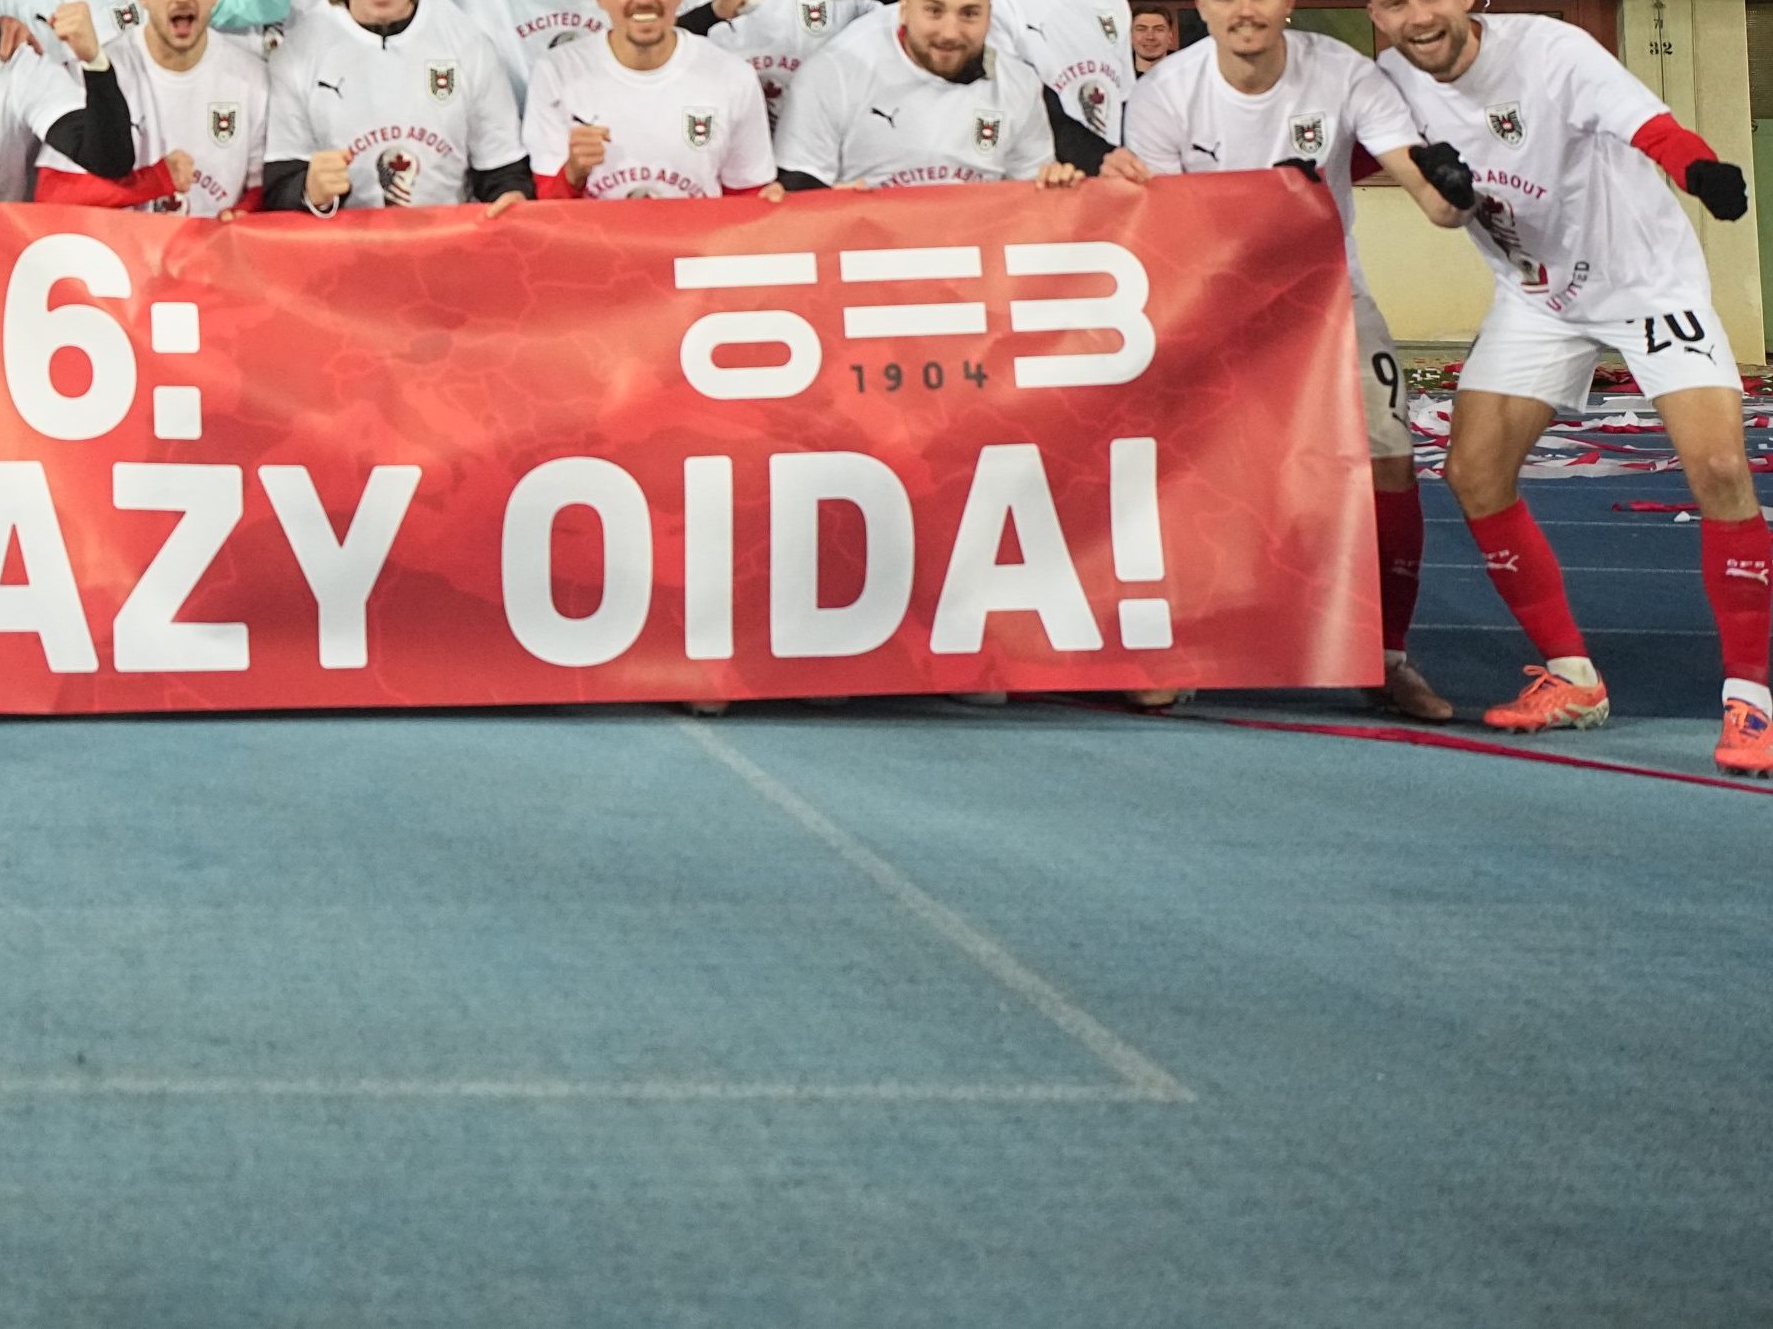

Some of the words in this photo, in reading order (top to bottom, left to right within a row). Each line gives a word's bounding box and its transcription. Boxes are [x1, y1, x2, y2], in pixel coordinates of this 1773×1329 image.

[516, 12, 581, 40] EXCITED
[1649, 41, 1673, 55] 32
[406, 127, 456, 159] ABOUT
[1486, 170, 1548, 201] ABOUT
[850, 362, 989, 394] 1904
[501, 436, 1173, 668] OIDA!
